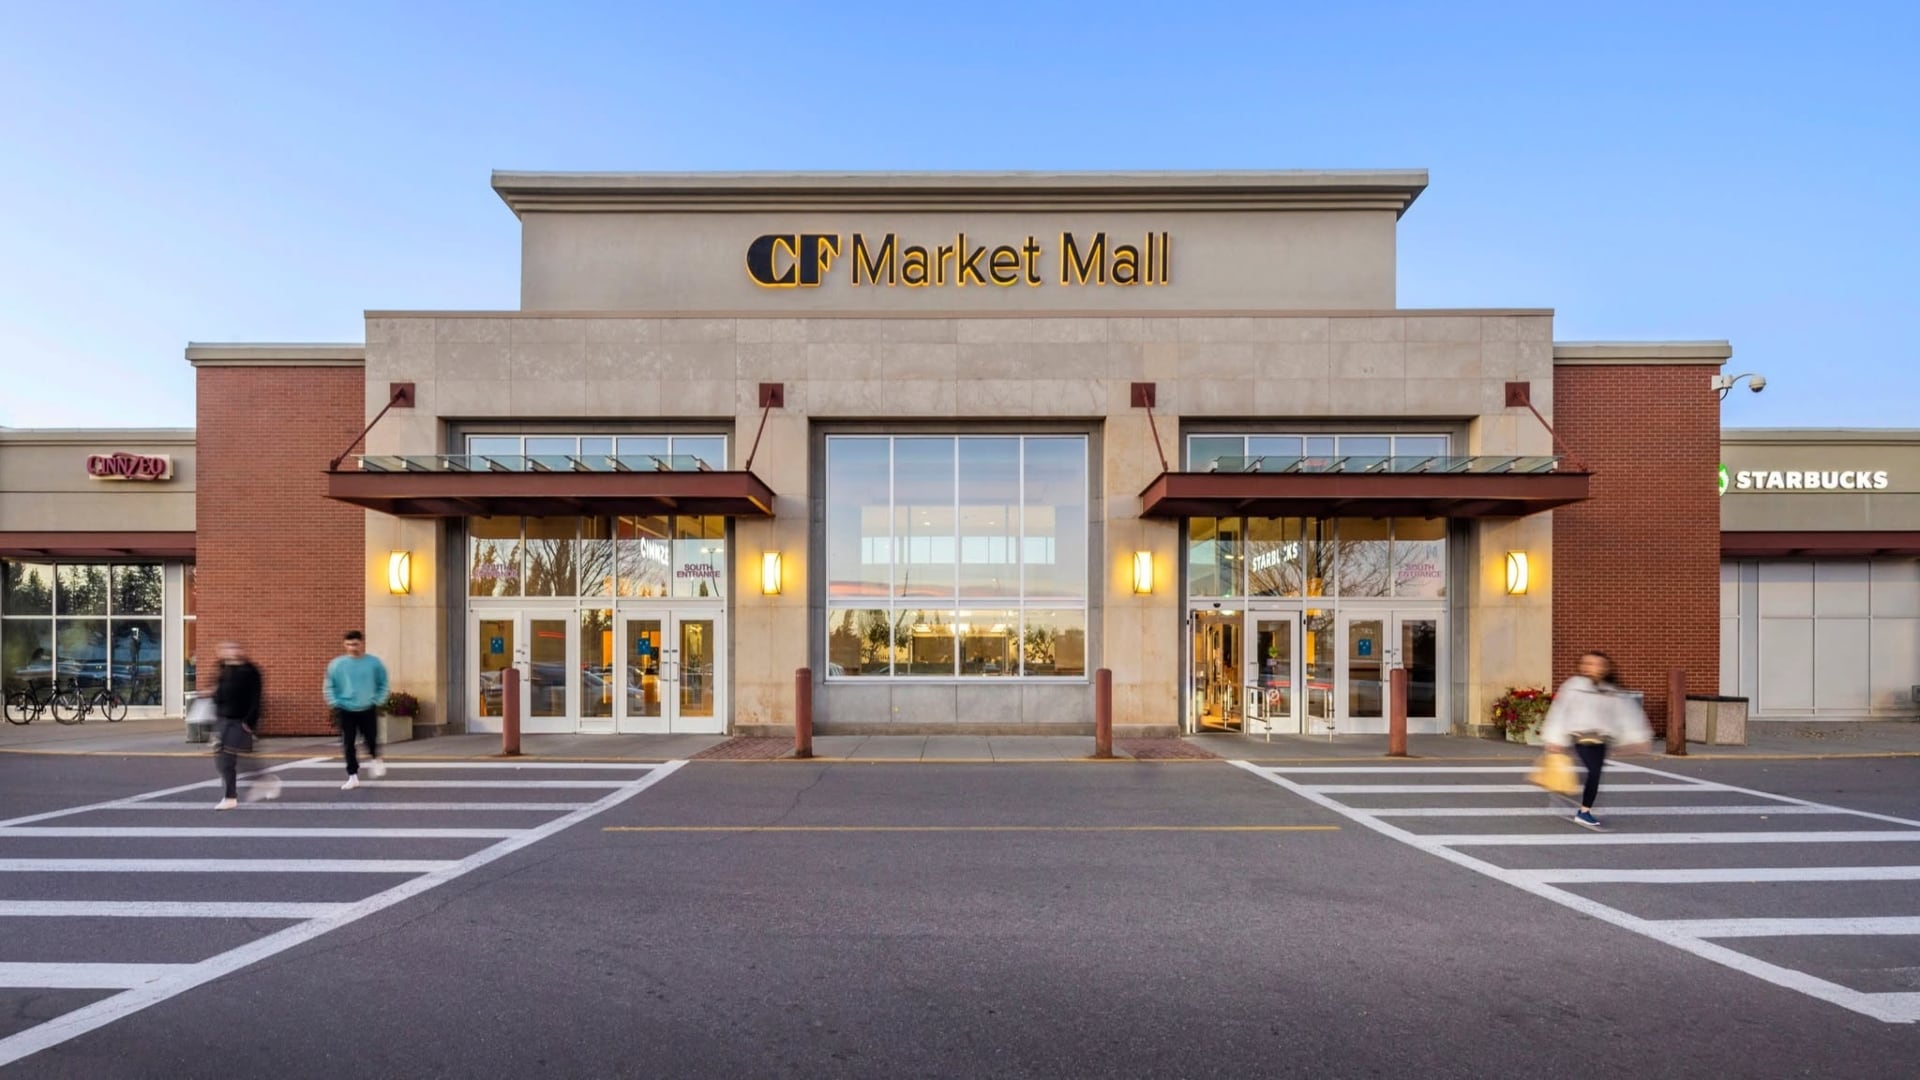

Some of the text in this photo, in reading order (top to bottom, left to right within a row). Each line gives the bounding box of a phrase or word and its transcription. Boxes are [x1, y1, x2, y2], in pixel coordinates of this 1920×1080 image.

[746, 231, 1169, 287] CF Market Mall
[86, 451, 167, 480] CINNZEO
[1735, 470, 1889, 490] STARBUCKS
[676, 570, 721, 578] ENTRANCE
[684, 563, 713, 571] SOUTH
[1398, 570, 1441, 578] ENTRANCE
